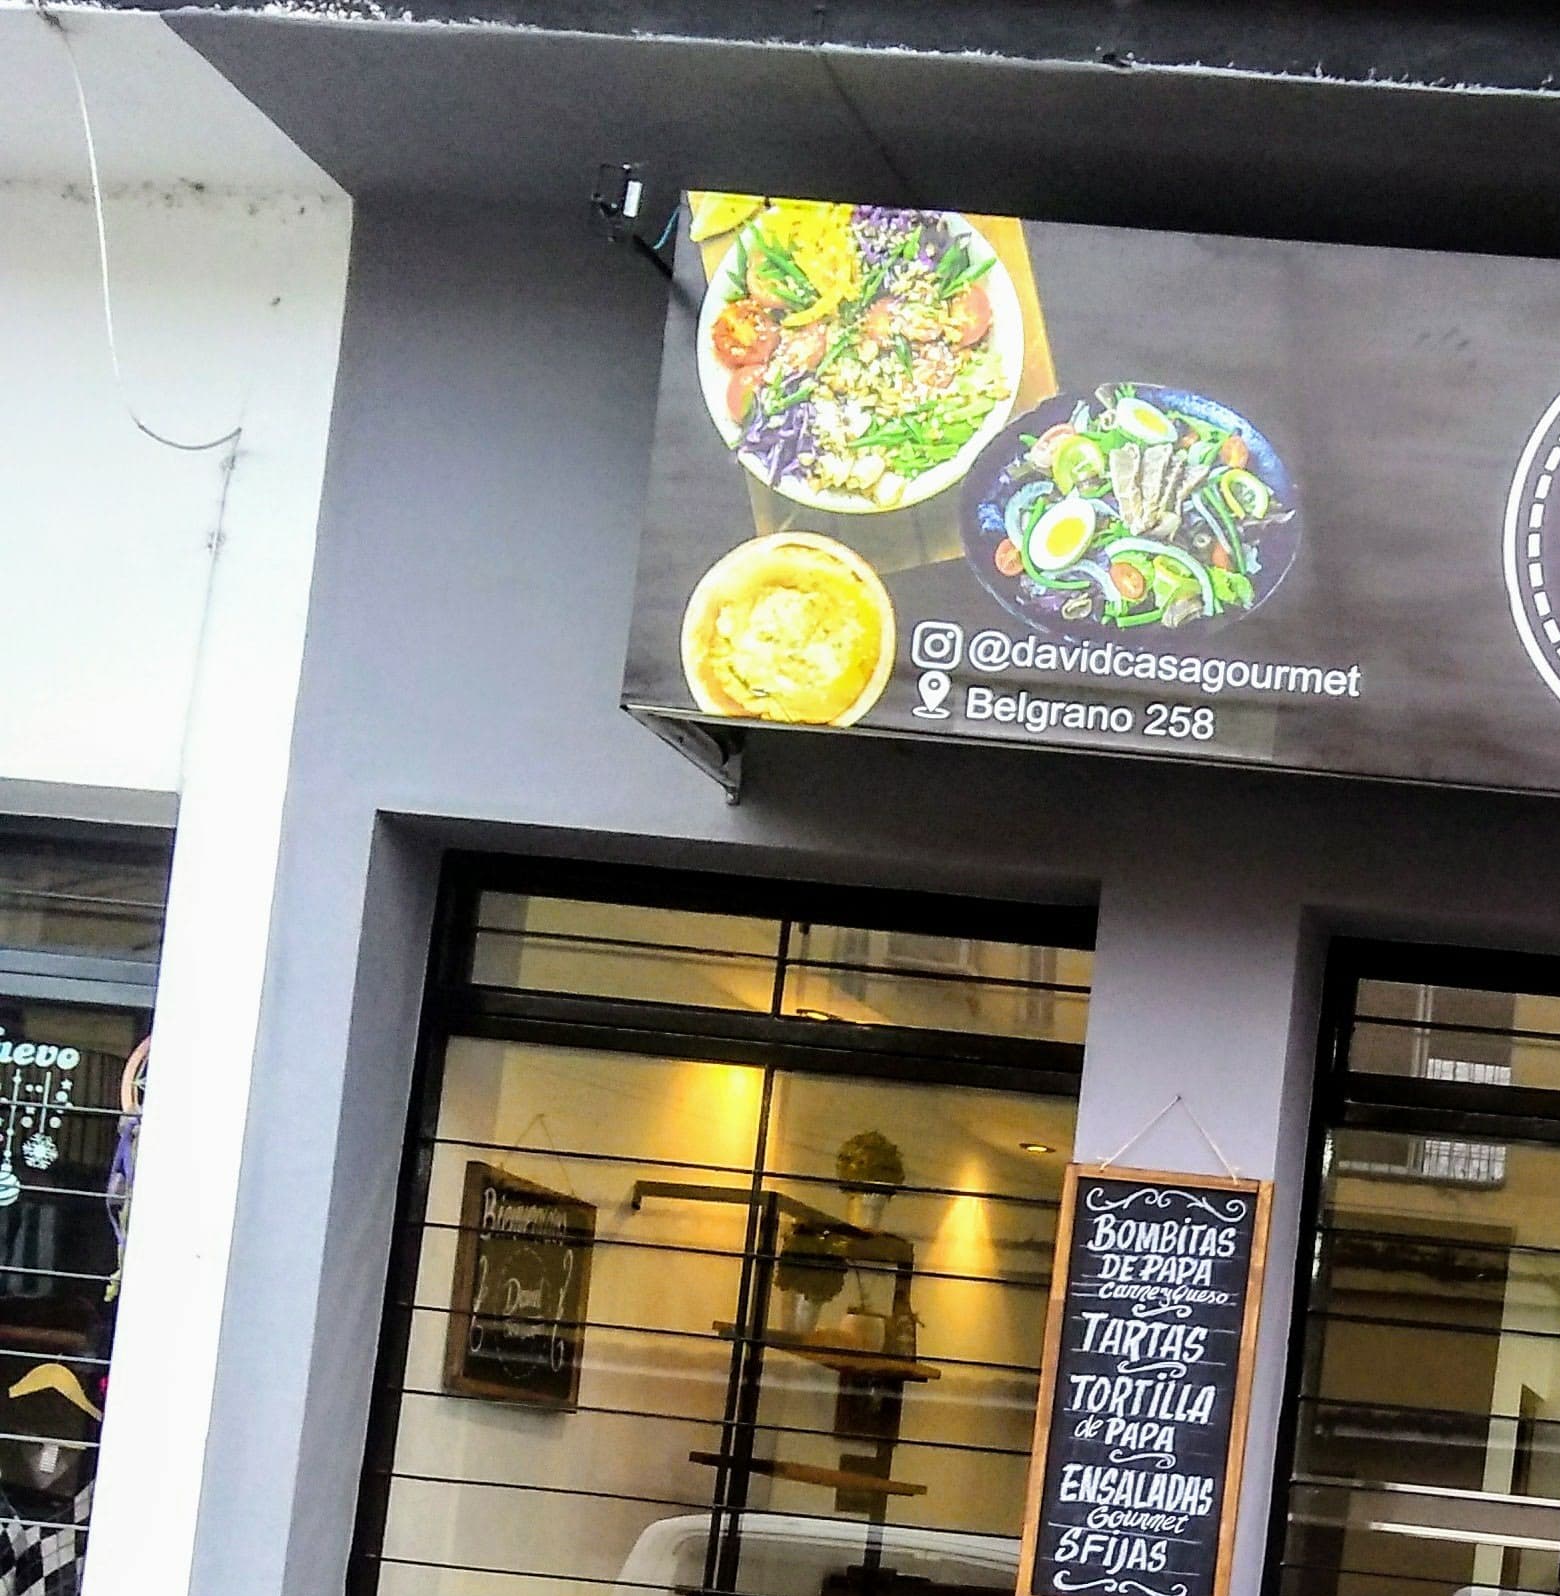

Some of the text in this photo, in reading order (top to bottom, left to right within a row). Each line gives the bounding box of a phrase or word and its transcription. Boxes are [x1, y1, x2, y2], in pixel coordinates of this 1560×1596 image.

[968, 629, 1362, 698] @davidcasagourmet
[966, 687, 1215, 740] Belgrano 258
[1098, 1253, 1213, 1287] DE PAPA
[1099, 1281, 1230, 1307] Carne y Queso
[1081, 1311, 1209, 1363] TARTAS
[1074, 1412, 1176, 1453] de PAPA
[1060, 1462, 1214, 1517] ENSALADAS
[1087, 1504, 1190, 1534] Gourmet
